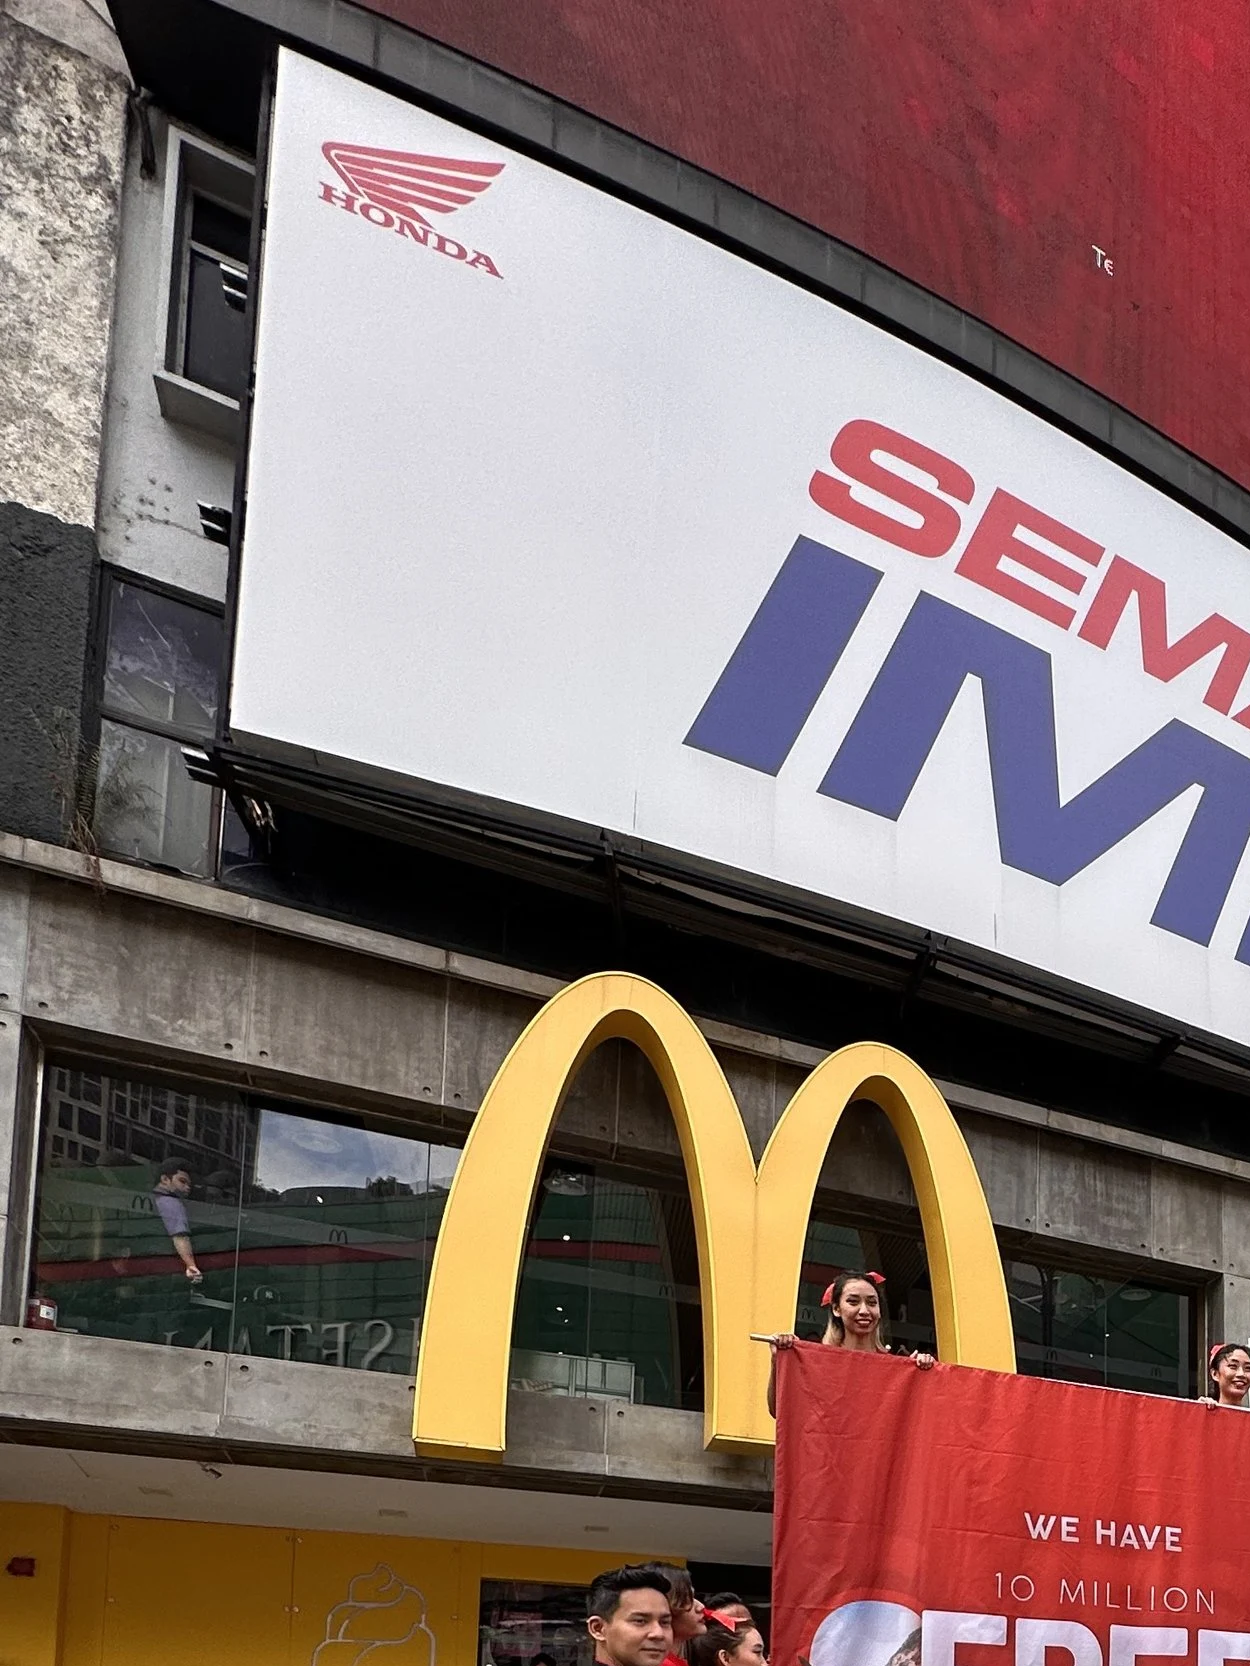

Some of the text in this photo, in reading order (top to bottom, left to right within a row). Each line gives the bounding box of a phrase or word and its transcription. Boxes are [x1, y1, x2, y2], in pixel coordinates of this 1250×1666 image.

[319, 181, 504, 279] HONDA
[1024, 1512, 1183, 1552] WE HAVE
[995, 1572, 1215, 1614] 10 MILLION
